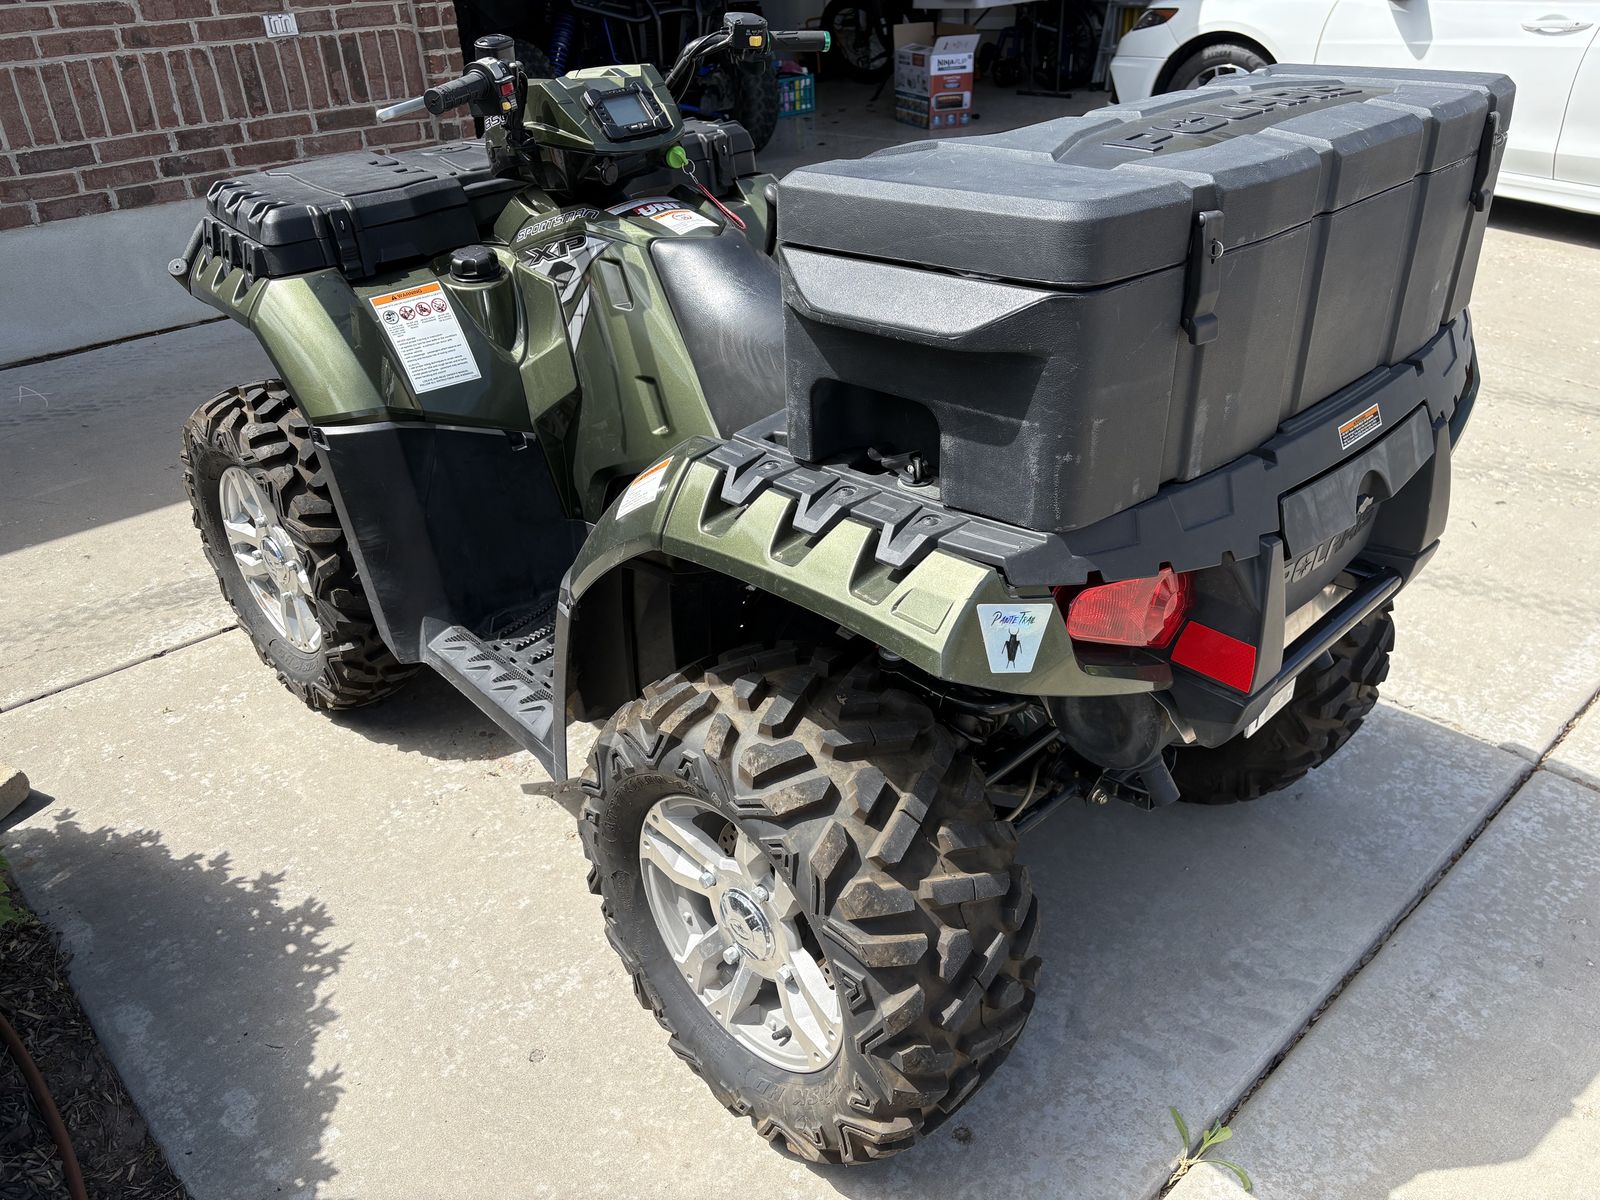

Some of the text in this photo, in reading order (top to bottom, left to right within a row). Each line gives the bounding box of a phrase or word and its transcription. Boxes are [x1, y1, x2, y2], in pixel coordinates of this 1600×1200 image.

[937, 58, 954, 66] NINJA
[516, 207, 600, 243] SPORTSMAN
[525, 233, 587, 268] XP
[397, 288, 423, 299] WARNING
